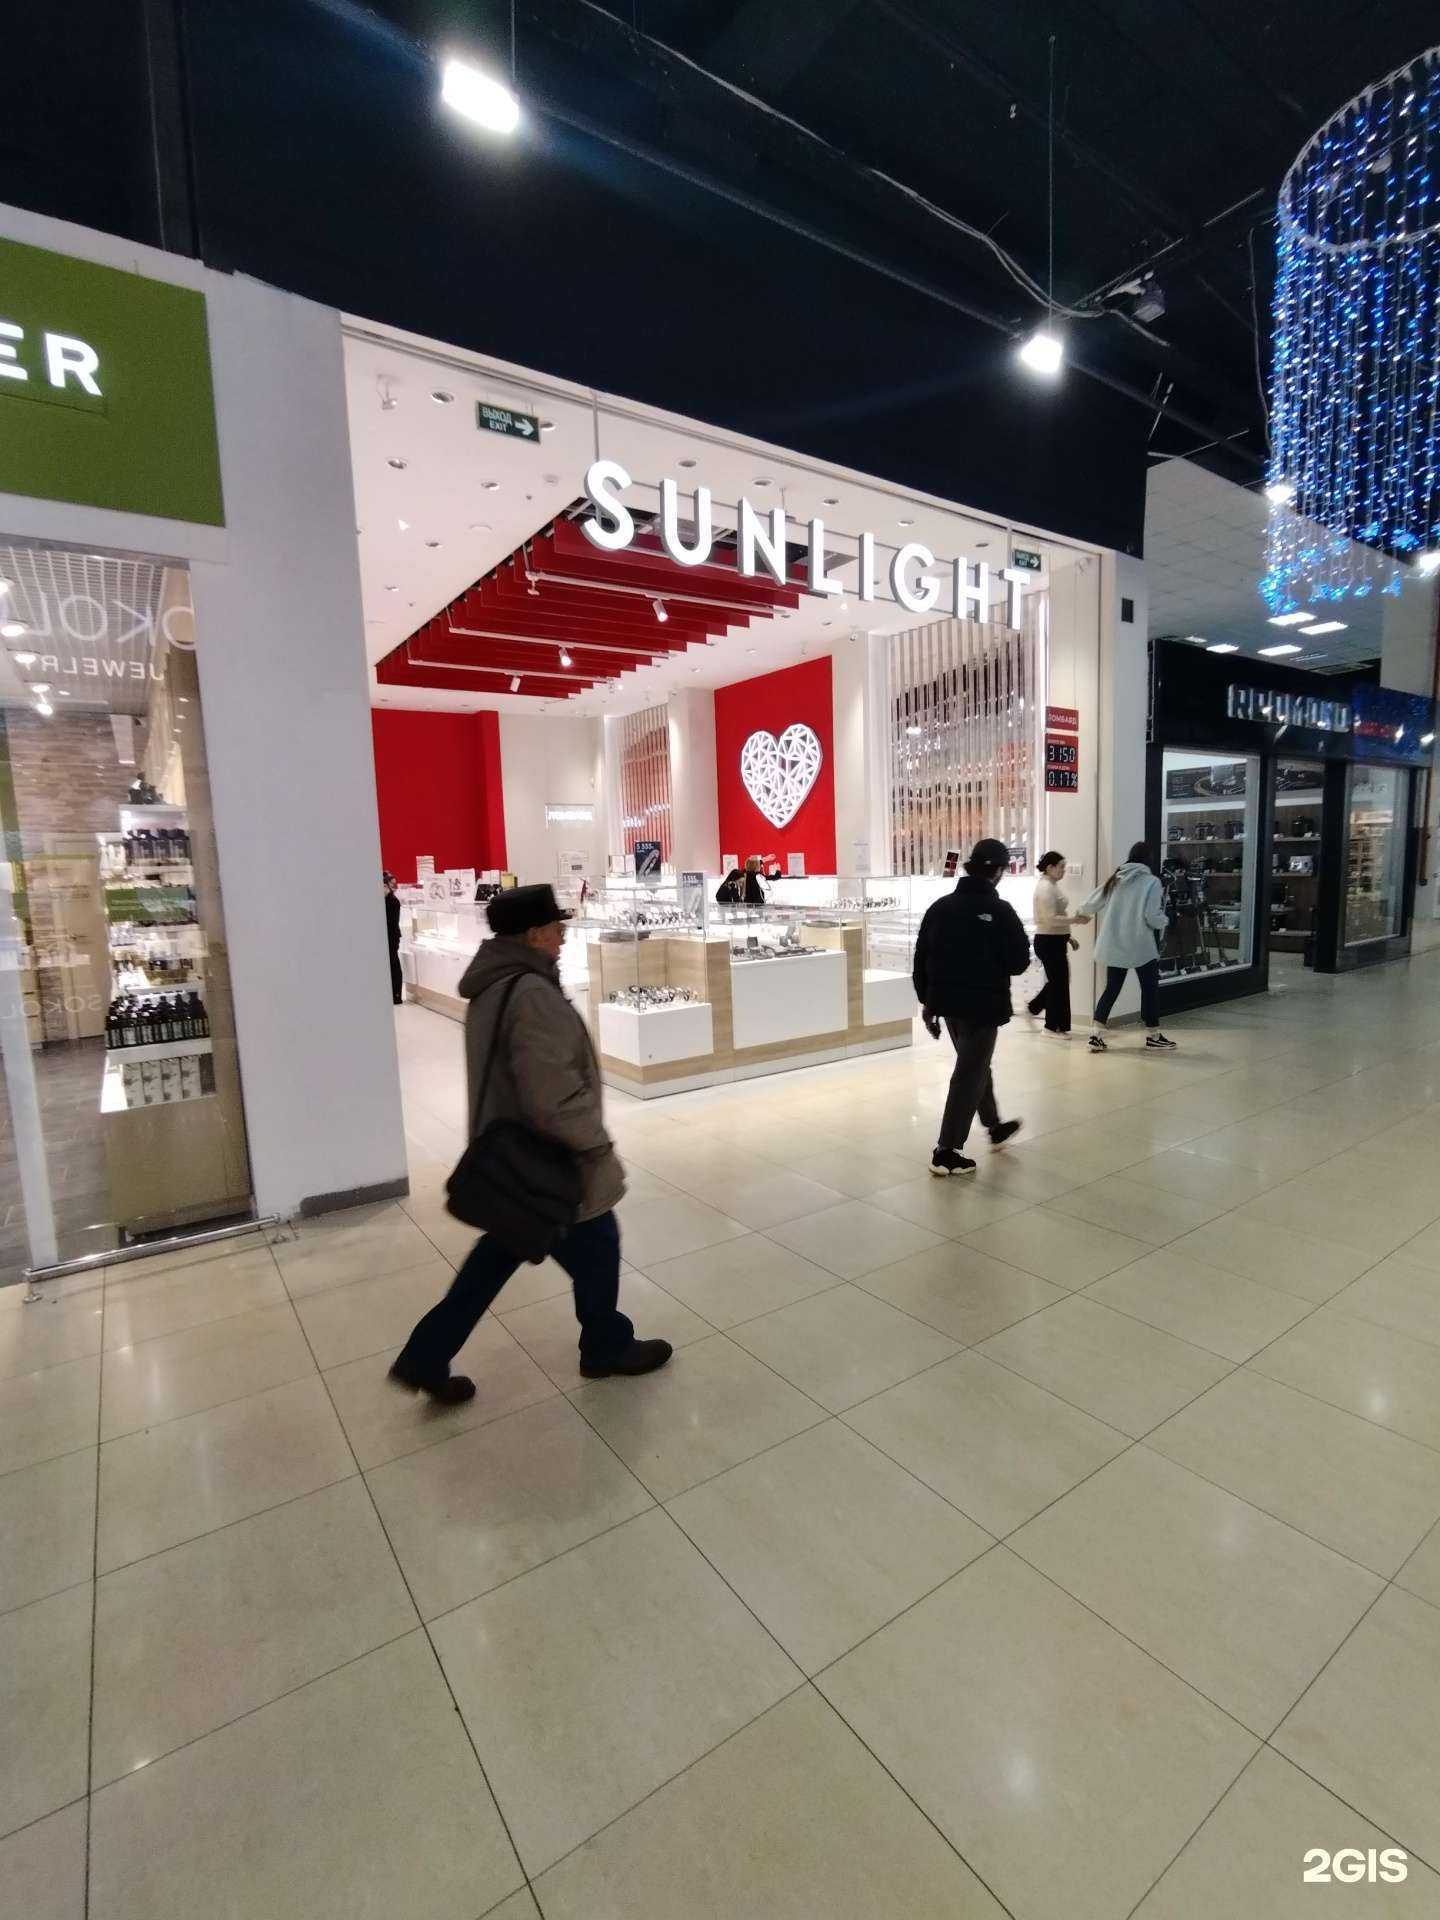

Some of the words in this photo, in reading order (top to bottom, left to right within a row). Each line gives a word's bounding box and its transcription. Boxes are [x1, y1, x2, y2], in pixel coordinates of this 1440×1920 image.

[482, 406, 513, 426] ВЫХОД
[489, 419, 508, 433] EXIT
[580, 460, 1031, 631] SUNLIGHT
